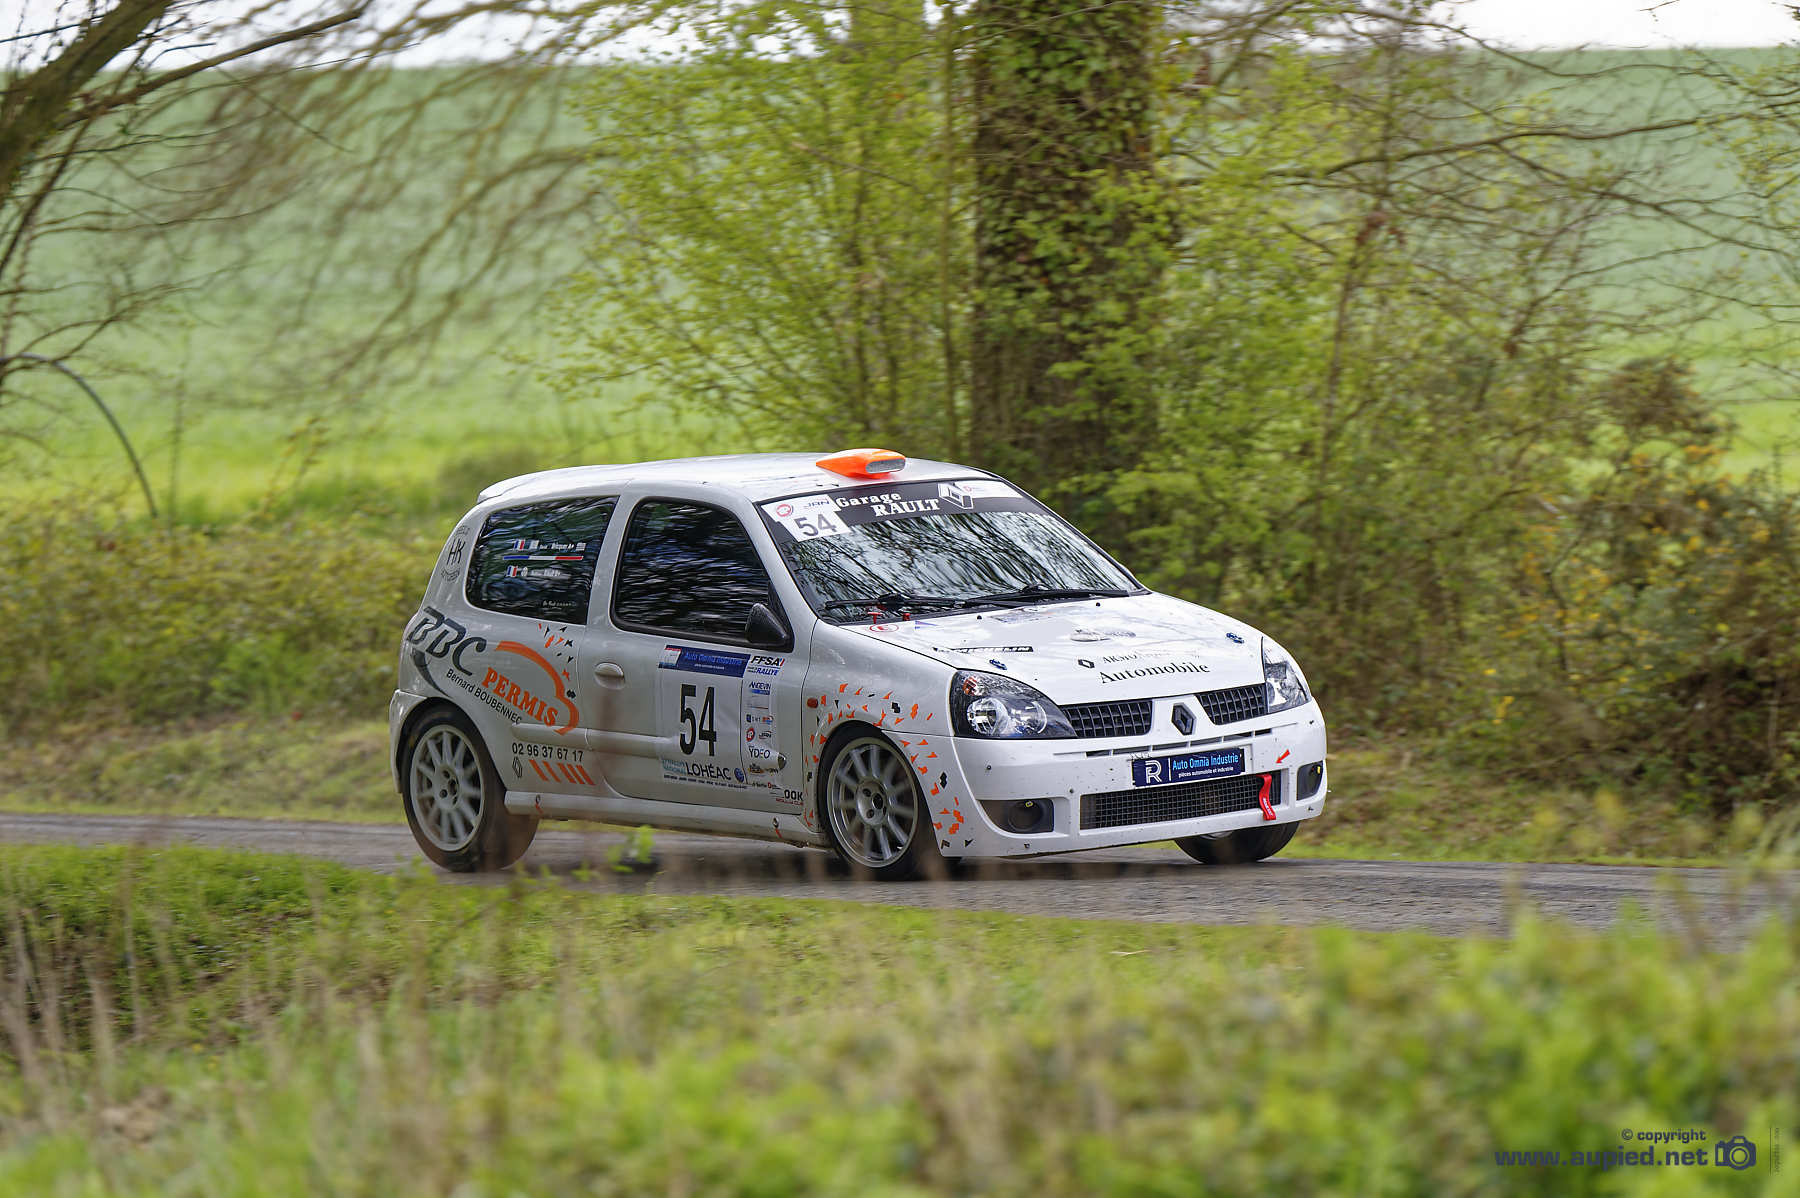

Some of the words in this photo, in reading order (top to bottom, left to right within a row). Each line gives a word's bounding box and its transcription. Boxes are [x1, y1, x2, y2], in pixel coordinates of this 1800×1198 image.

[837, 492, 902, 508] Garage
[870, 498, 940, 517] RAULT
[794, 513, 838, 537] 54
[446, 538, 466, 565] HK
[407, 605, 487, 676] BBC
[751, 655, 780, 667] FFSA
[756, 667, 779, 676] RALLYE
[1099, 661, 1211, 684] Automobile
[446, 668, 476, 694] Bernard
[474, 689, 523, 725] BOUBENNEC
[481, 666, 559, 727] PERMIS
[679, 683, 717, 757] 54
[511, 742, 524, 755] 02
[526, 744, 539, 757] 96
[541, 745, 554, 759] 37
[556, 747, 569, 760] 67
[572, 749, 584, 762] 17
[1172, 759, 1188, 771] Auto
[1189, 757, 1210, 769] Omnia
[1210, 752, 1239, 766] Industrie
[685, 761, 732, 781] LOHÉAC
